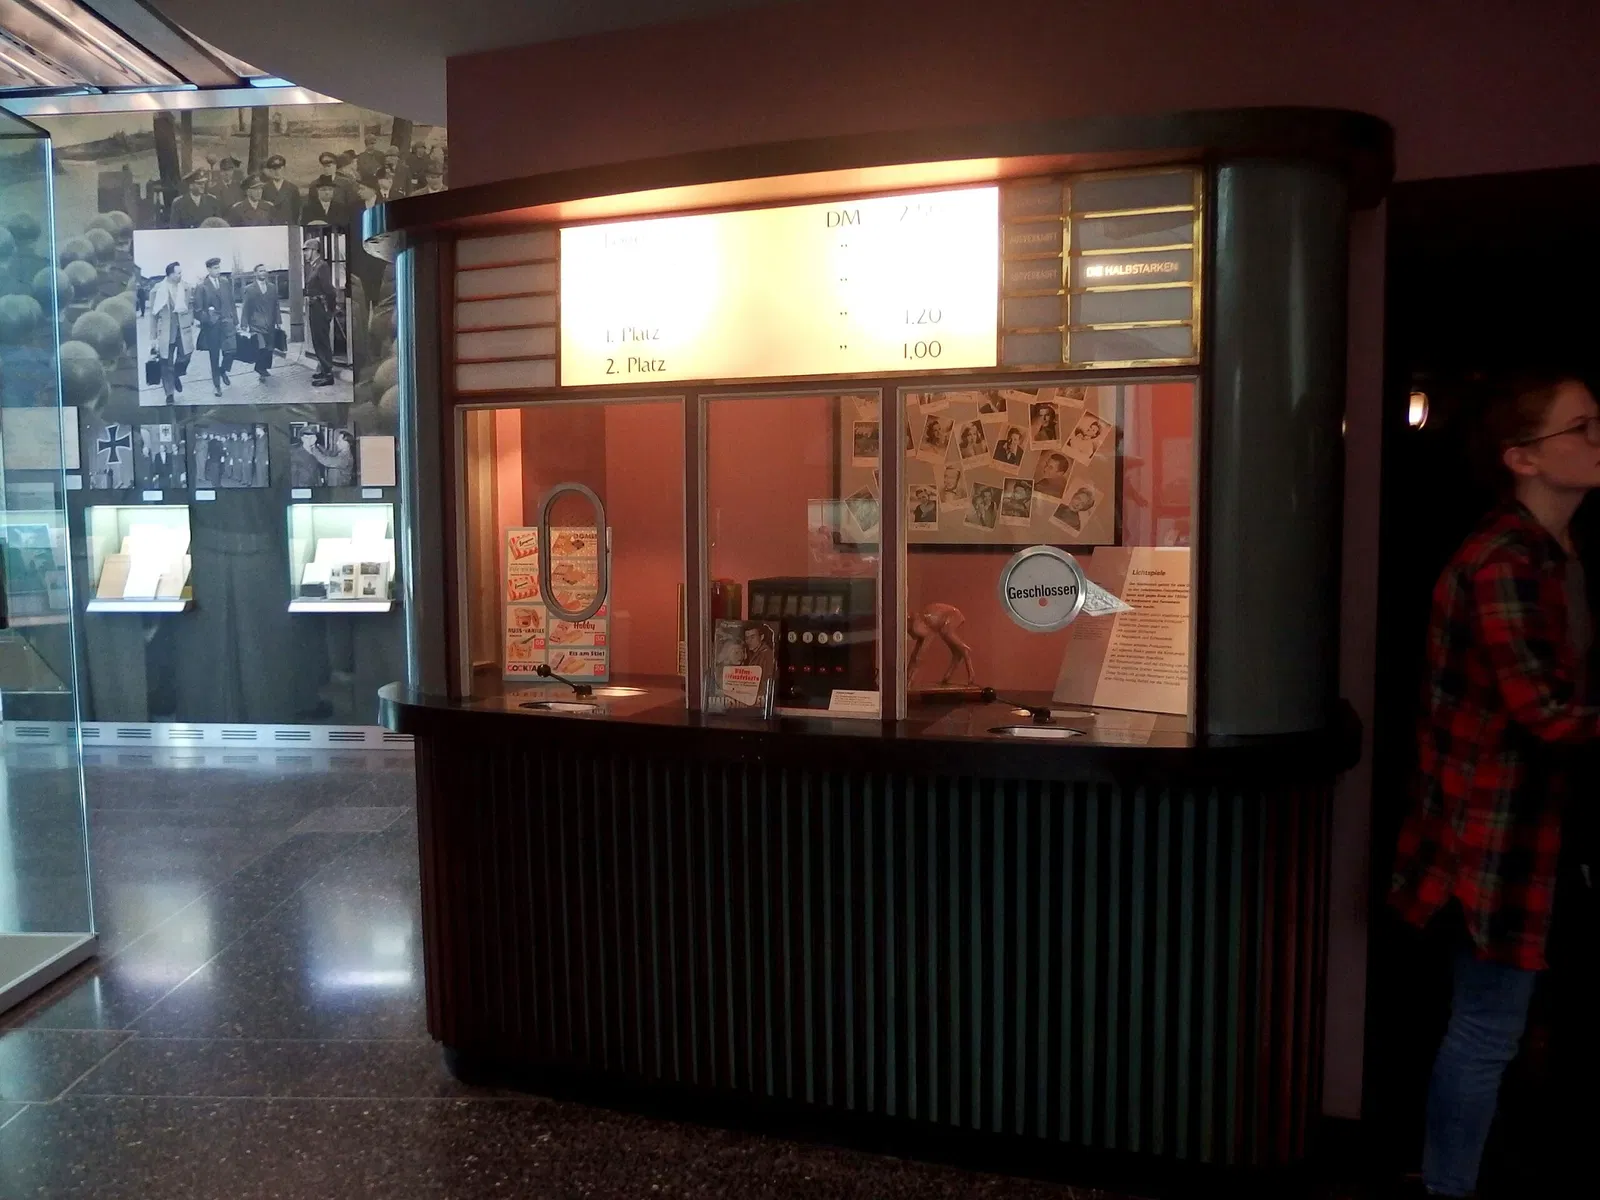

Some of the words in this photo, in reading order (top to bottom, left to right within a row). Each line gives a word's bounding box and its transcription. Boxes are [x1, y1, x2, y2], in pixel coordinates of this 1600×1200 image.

[826, 209, 861, 228] DM
[1086, 265, 1103, 278] DIE
[1104, 262, 1179, 277] HALBSTARKEN
[606, 329, 614, 343] 1.
[621, 326, 661, 343] Platz
[605, 358, 620, 375] 2.
[627, 356, 667, 374] Platz
[904, 340, 942, 360] 1,00
[1132, 569, 1166, 577] Lichtspiele
[1008, 584, 1077, 600] Geschlossen
[573, 621, 596, 630] Hobby
[507, 664, 538, 672] COCKTA
